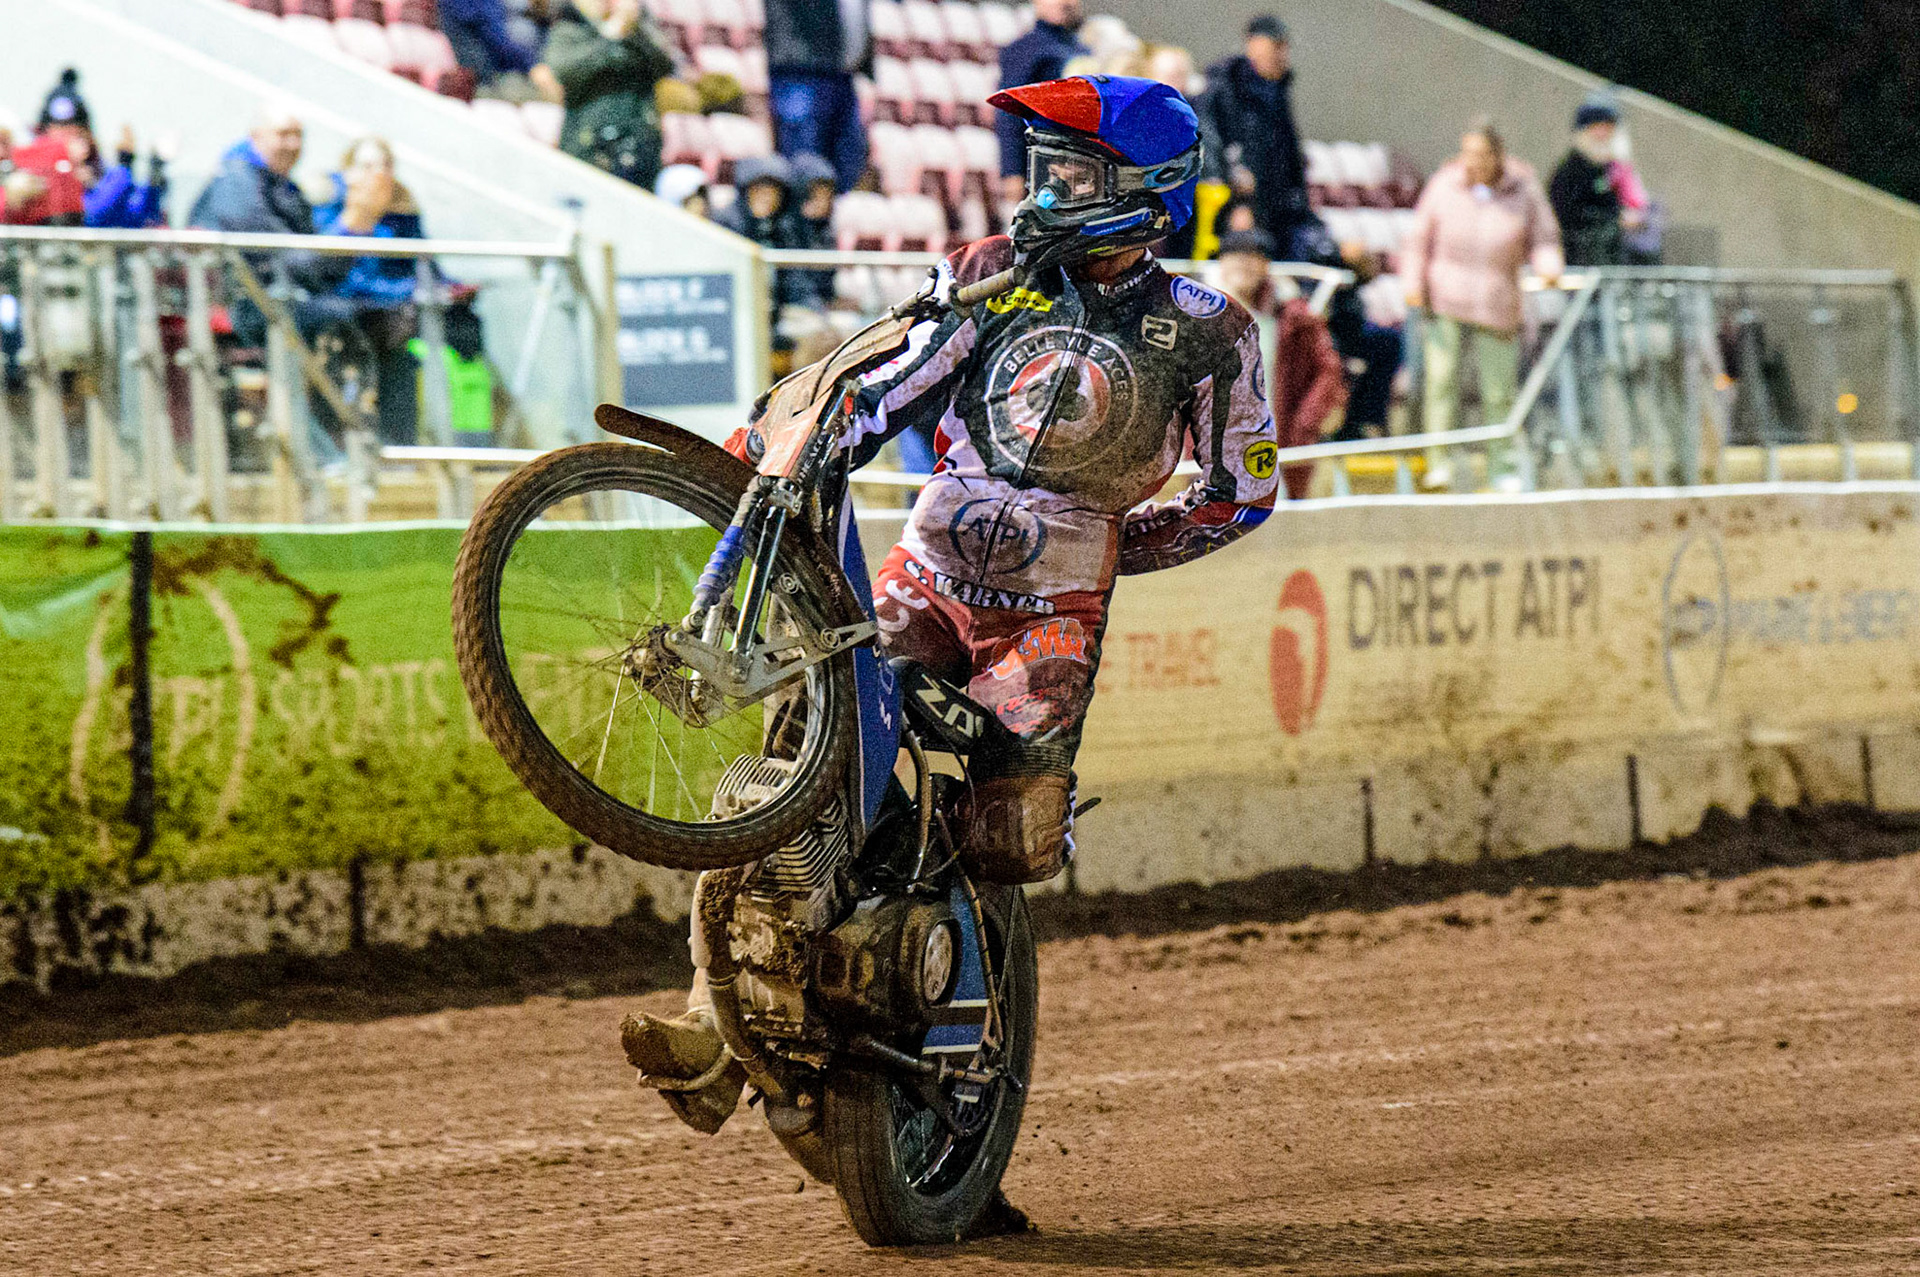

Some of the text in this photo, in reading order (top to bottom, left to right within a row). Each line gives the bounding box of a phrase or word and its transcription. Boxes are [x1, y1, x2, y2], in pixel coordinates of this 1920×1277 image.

[1181, 284, 1217, 307] ATPI
[1004, 337, 1056, 373] BELLE
[1101, 357, 1129, 401] ACES
[1348, 562, 1503, 650] DIRECT
[1514, 555, 1600, 640] ATPI
